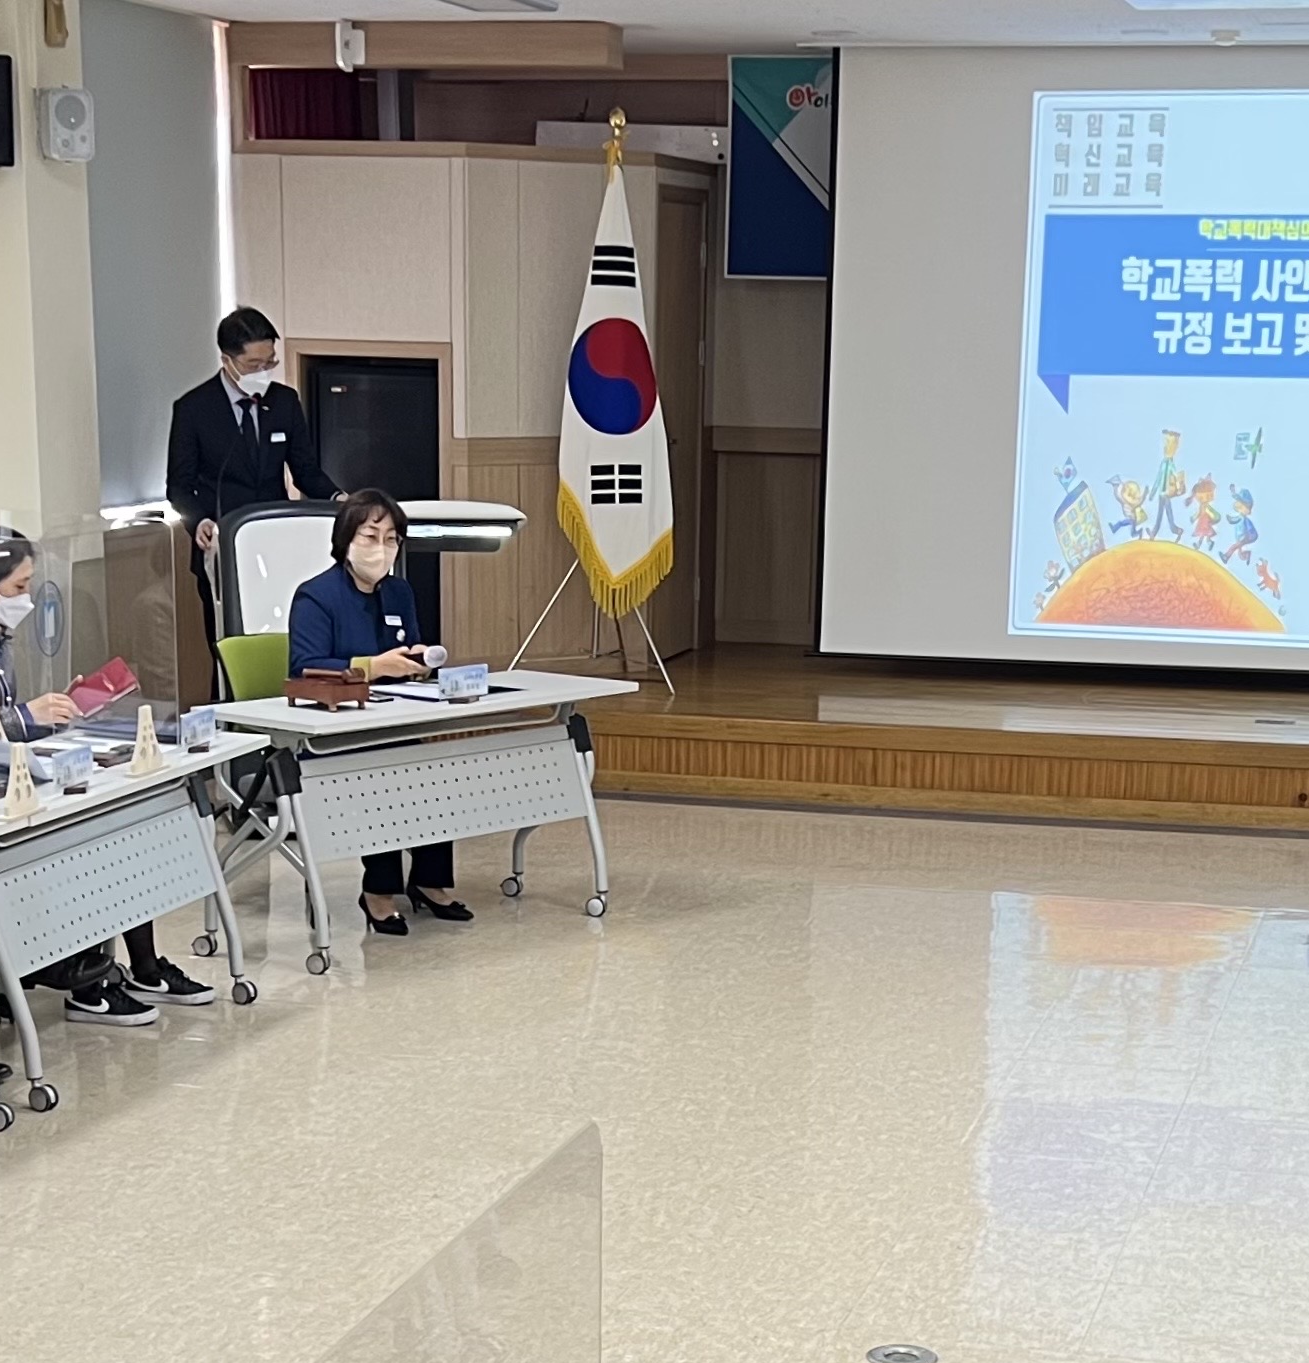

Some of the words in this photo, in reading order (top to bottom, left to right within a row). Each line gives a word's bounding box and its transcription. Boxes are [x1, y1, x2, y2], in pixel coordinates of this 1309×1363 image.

[1122, 256, 1243, 302] 학교폭력
[1152, 311, 1213, 355] 규정
[1222, 312, 1284, 355] 보고
